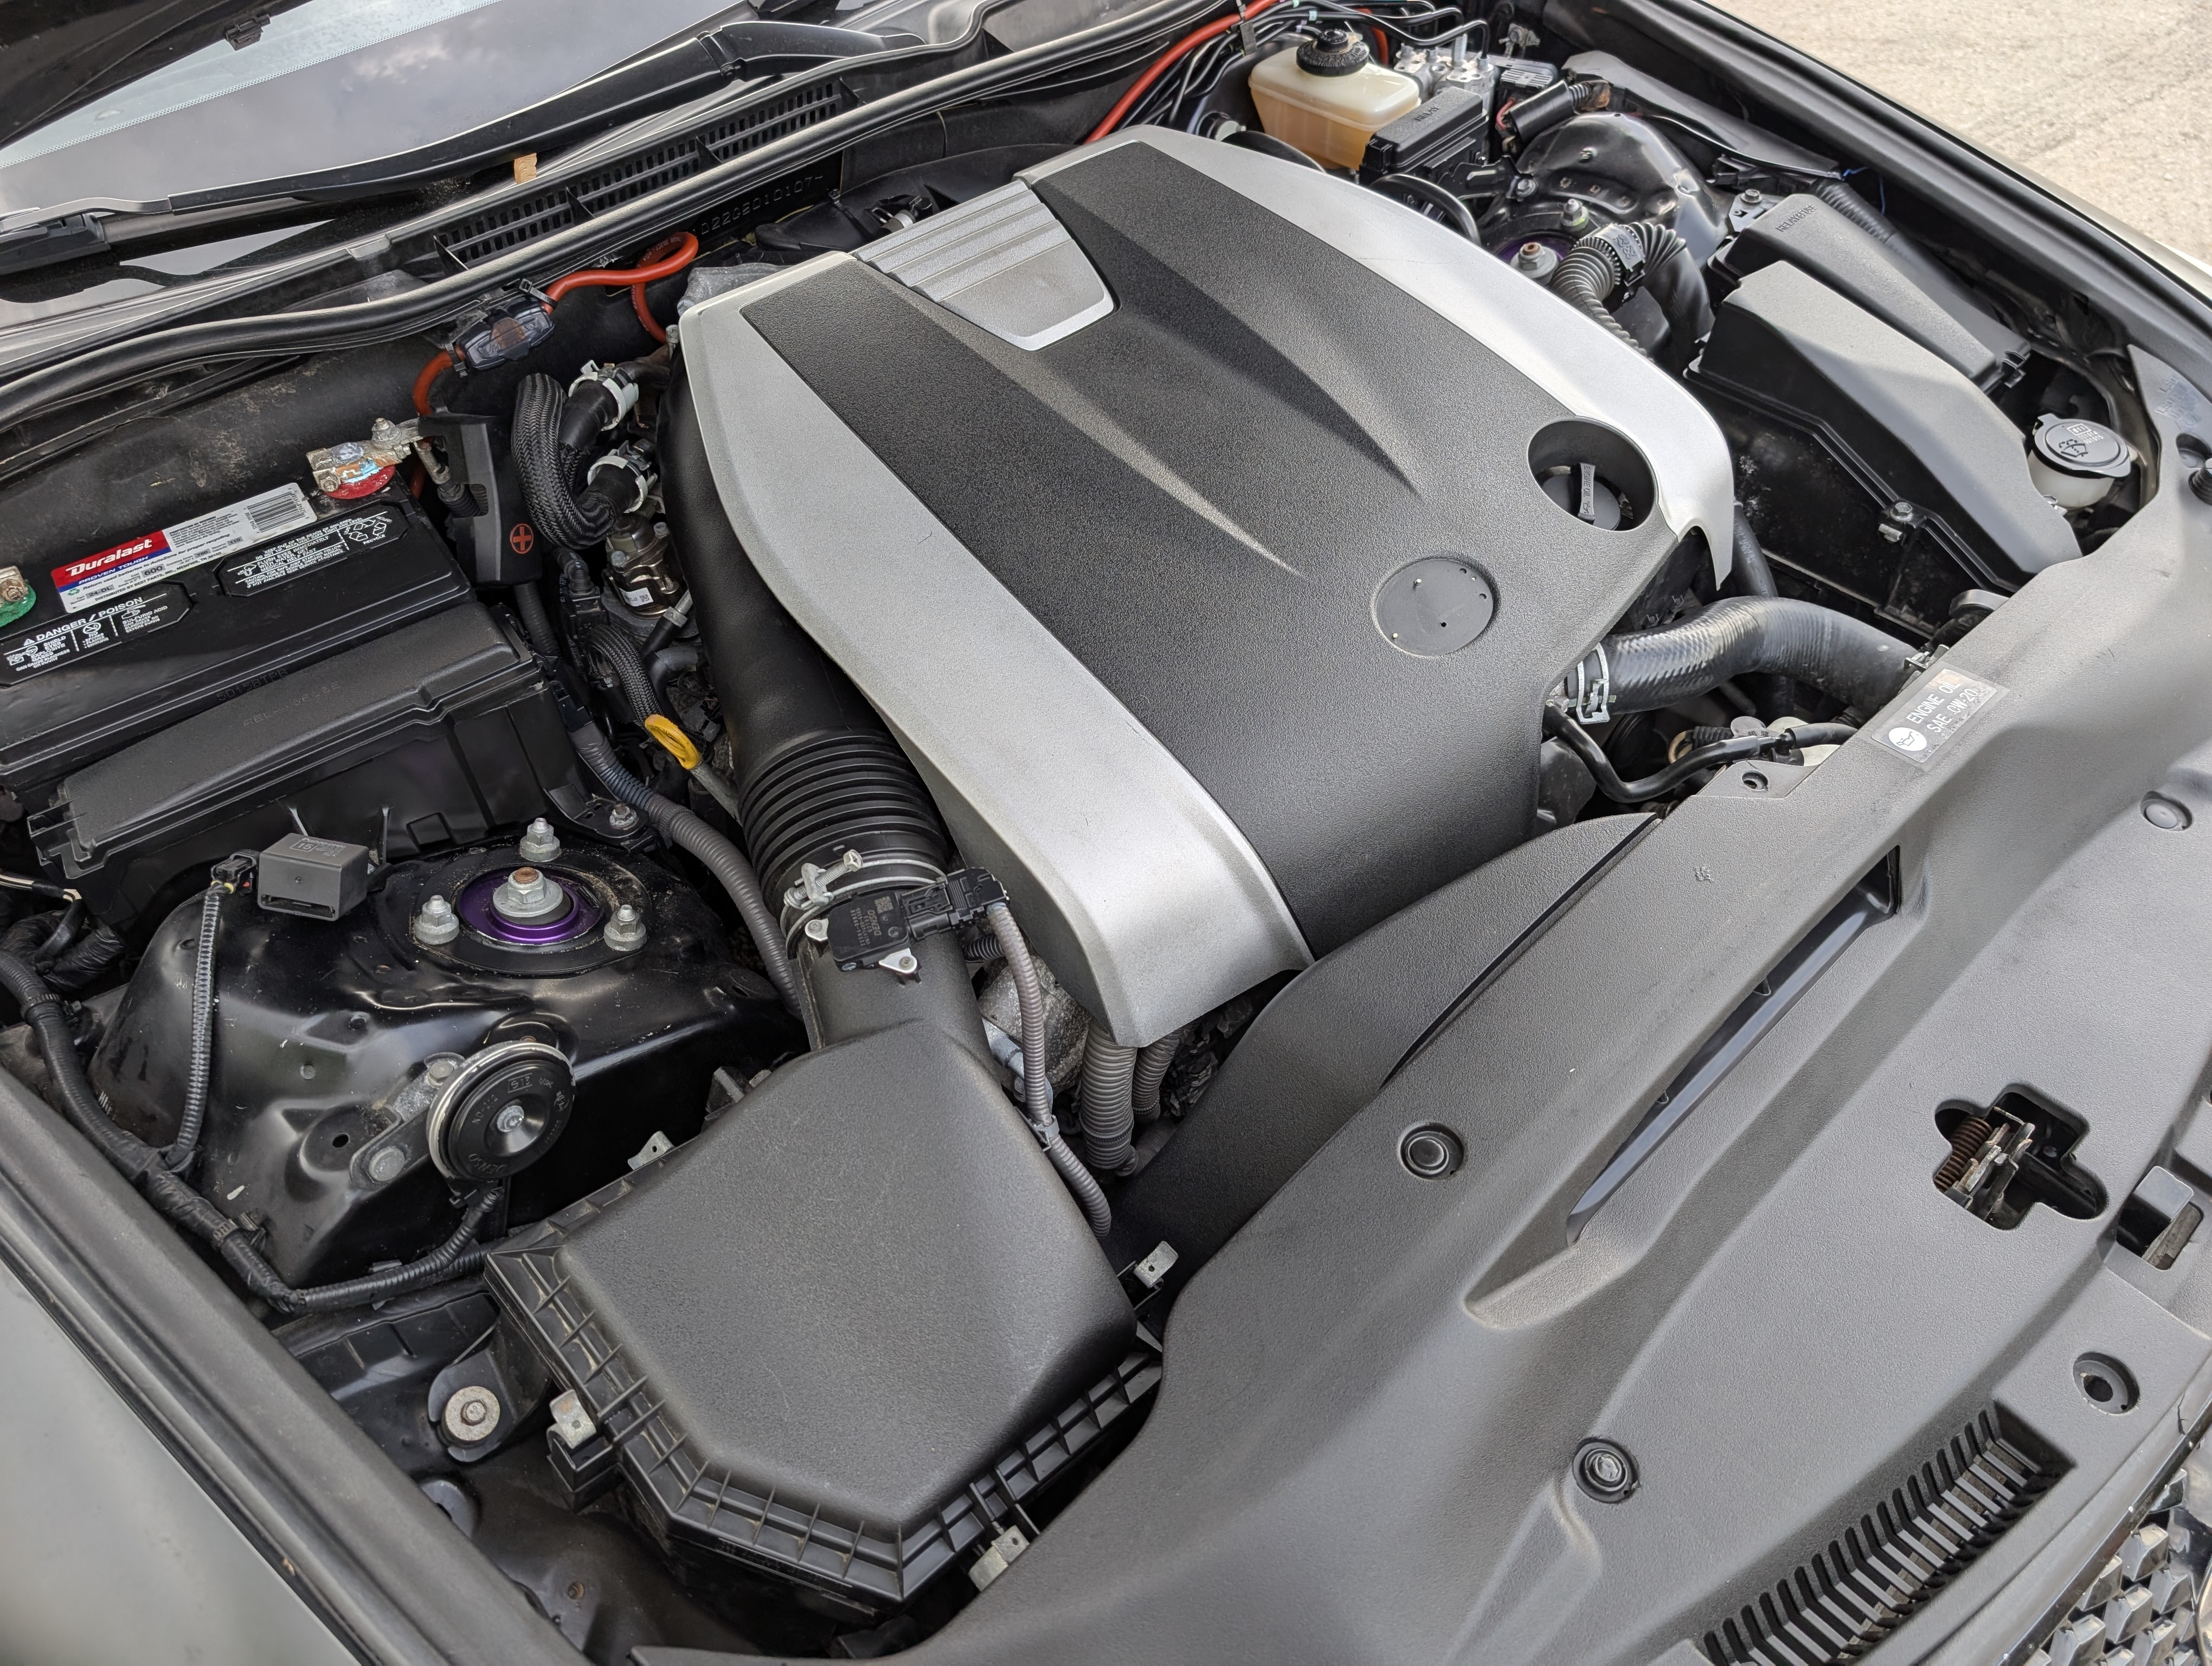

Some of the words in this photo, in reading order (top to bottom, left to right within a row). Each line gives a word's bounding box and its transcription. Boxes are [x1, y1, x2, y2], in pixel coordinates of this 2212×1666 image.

[1413, 104, 1439, 121] RELAY
[306, 529, 321, 538] REACH
[329, 518, 352, 529] CHILDREN
[363, 534, 385, 544] RECYCLE
[65, 537, 152, 576] Duralast
[257, 556, 276, 566] FLUSH
[276, 550, 292, 558] EYES
[292, 535, 330, 552] IMMEDIATELY
[301, 551, 323, 562] STARTING
[82, 580, 103, 590] Return
[117, 565, 143, 577] batteries
[150, 553, 177, 565] AutoZone
[187, 542, 205, 552] proper
[205, 533, 230, 545] recycling
[259, 561, 274, 569] WITH
[260, 560, 285, 572] MEDICAL
[286, 554, 301, 562] HELP
[303, 548, 317, 556] FAST
[79, 568, 115, 584] PROVEN
[118, 555, 148, 569] TOUGH
[143, 565, 163, 576] 600
[94, 587, 126, 601] DISTRIBUTED
[146, 572, 164, 582] PARTS,
[176, 559, 200, 571] MEMPHIS,
[88, 586, 112, 597] 24-DL
[35, 617, 87, 641] DANGER
[98, 596, 143, 617] POISON
[122, 611, 153, 625] SULFURIC
[153, 605, 168, 613] ACID
[135, 615, 151, 623] CAUSE
[124, 618, 150, 630] BLINDNESS
[43, 635, 66, 646] SHIELD
[44, 641, 61, 650] EYES
[86, 635, 105, 644] FLAMES
[87, 637, 109, 648] SMOKING
[30, 643, 66, 659] EXPLOSIVE
[31, 651, 54, 662] GASES
[1906, 693, 1945, 723] ENGINE
[1938, 681, 1960, 693] OIL
[1926, 713, 1952, 733] SAE
[866, 910, 882, 935] DENSO
[468, 1154, 506, 1174] DENSO
